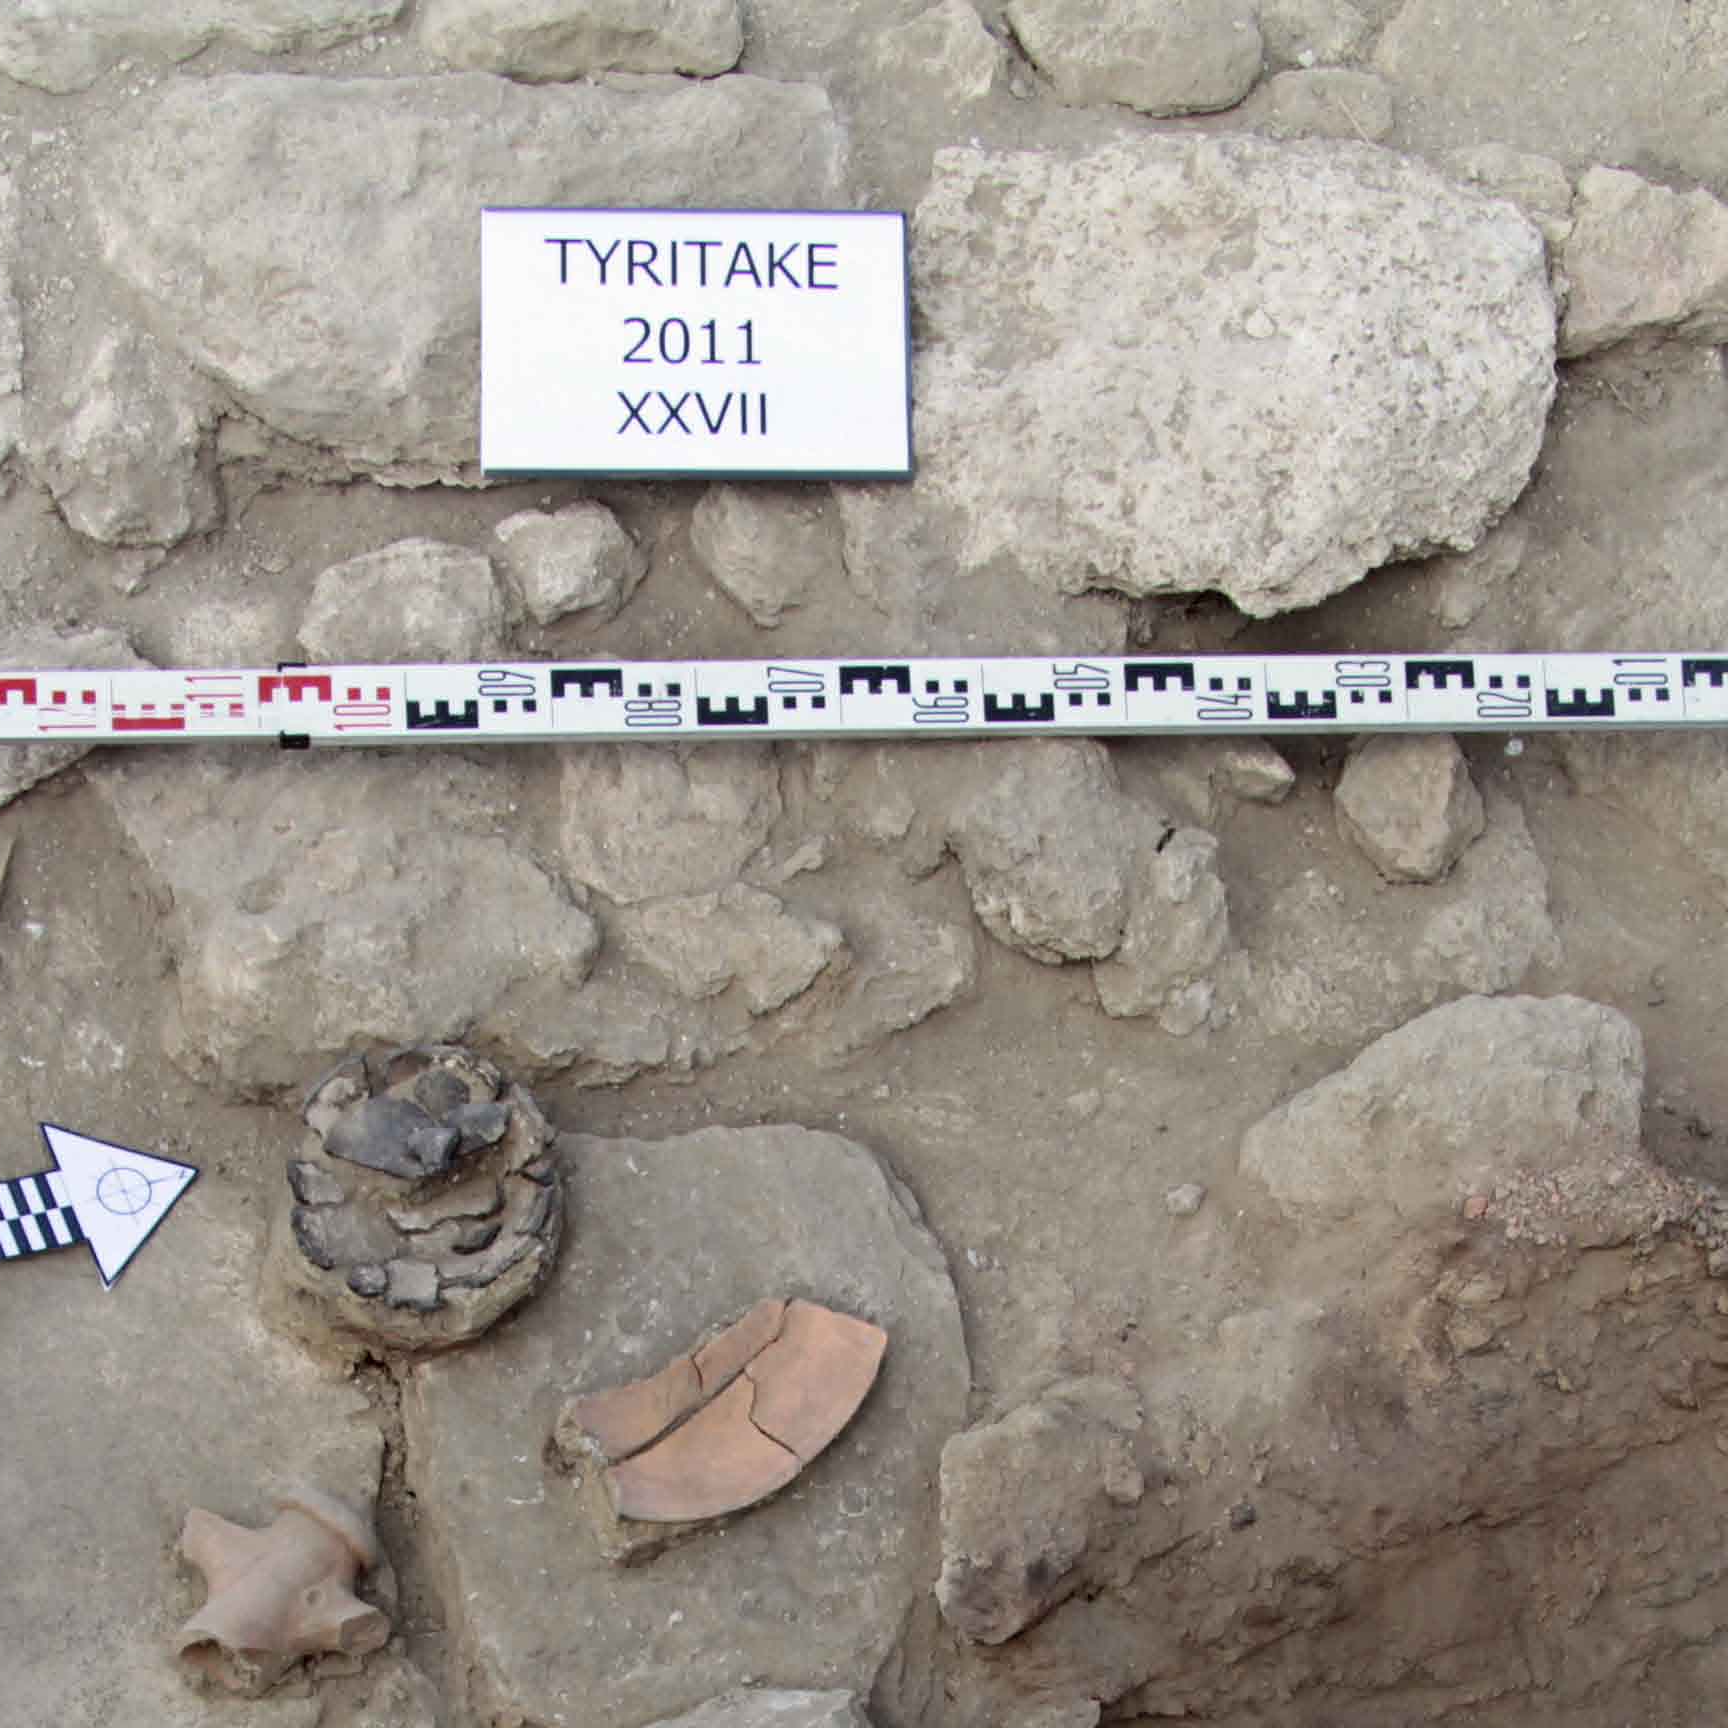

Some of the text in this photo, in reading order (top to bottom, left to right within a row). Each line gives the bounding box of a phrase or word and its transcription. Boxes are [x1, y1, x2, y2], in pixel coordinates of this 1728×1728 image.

[543, 237, 839, 290] TYRITAKE
[622, 317, 763, 365] 2011
[616, 391, 768, 435] XXVII
[478, 669, 536, 697] 09
[767, 666, 824, 693] 07
[1053, 663, 1110, 690] 05
[1335, 660, 1392, 687] 03
[1612, 658, 1669, 685] 01
[184, 675, 243, 701] 11
[333, 703, 392, 731] 10
[624, 699, 682, 727] 08
[911, 696, 969, 724] 06
[1196, 693, 1253, 721] 04
[1476, 690, 1533, 718] 02
